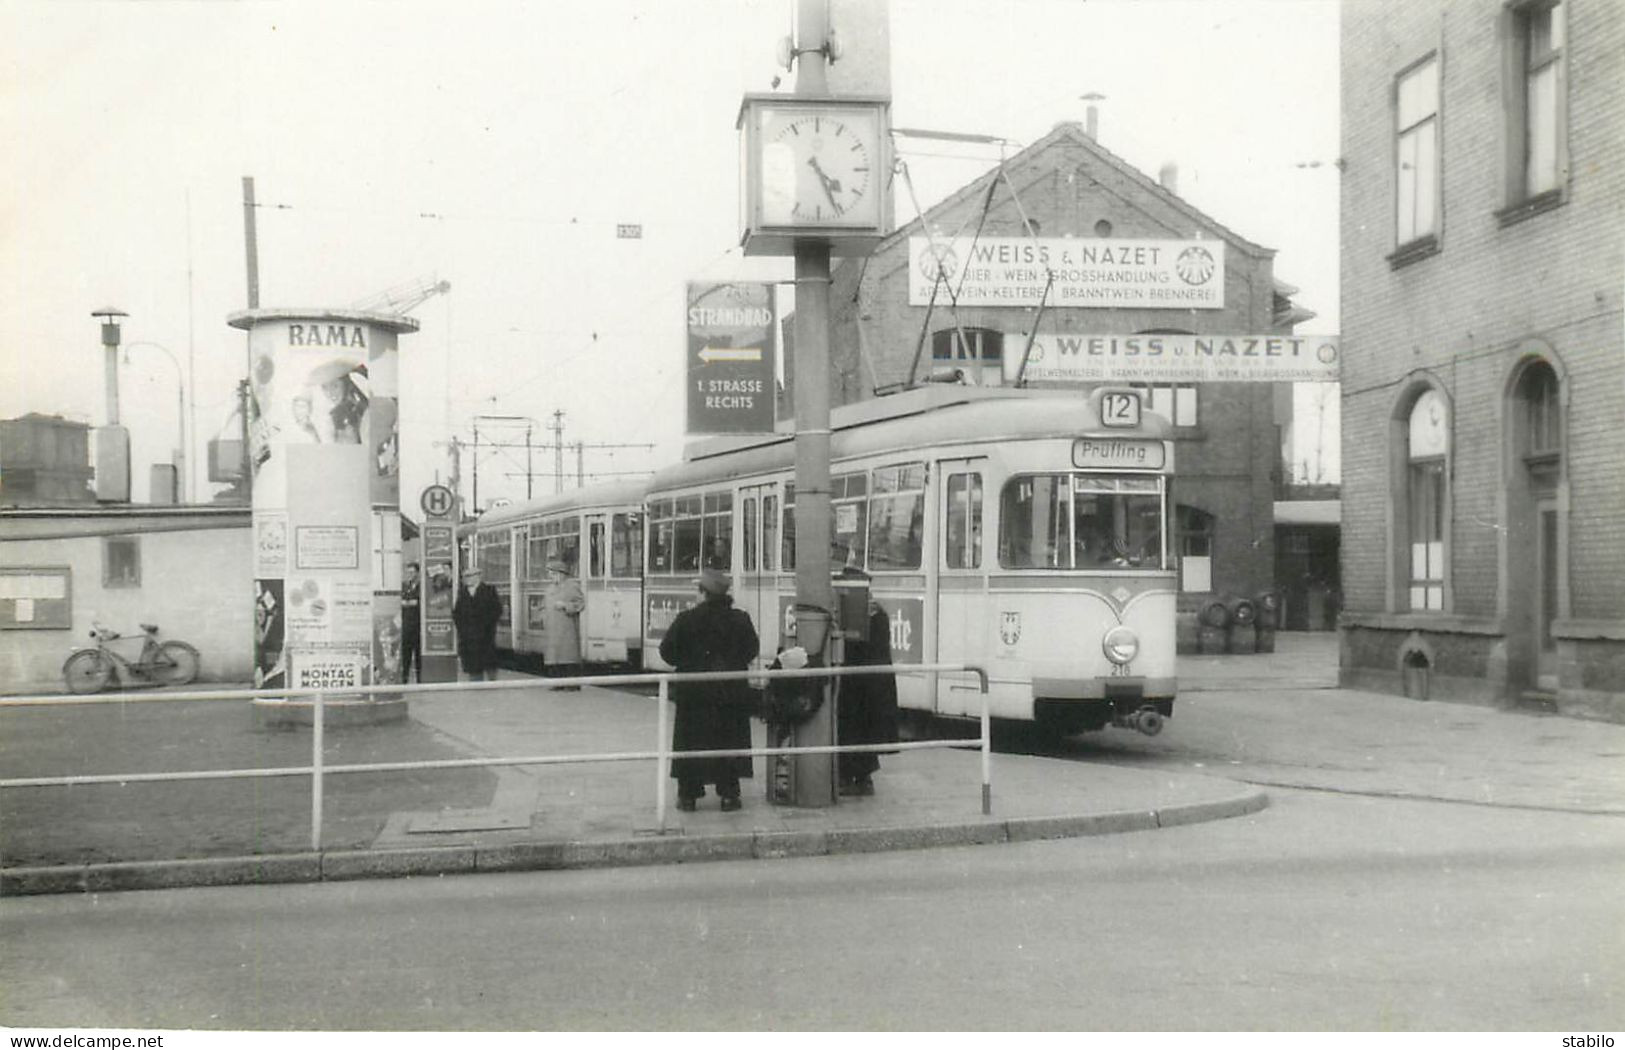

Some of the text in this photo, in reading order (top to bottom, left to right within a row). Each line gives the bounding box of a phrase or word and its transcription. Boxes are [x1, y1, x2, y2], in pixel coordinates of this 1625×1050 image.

[974, 245, 1161, 265] WEISS & NAZET
[1004, 269, 1037, 281] WEIN
[688, 308, 772, 327] STRANDBAD
[288, 324, 366, 349] RAMA
[1056, 338, 1164, 356] WEISS
[1194, 338, 1305, 357] NAZET
[708, 380, 764, 393] STRASSE
[705, 396, 754, 409] RECHTS
[1105, 395, 1131, 418] 12
[1082, 441, 1147, 463] Prüfling
[430, 492, 446, 510] H
[301, 669, 355, 679] MONTAG
[301, 680, 355, 689] MORGEN
